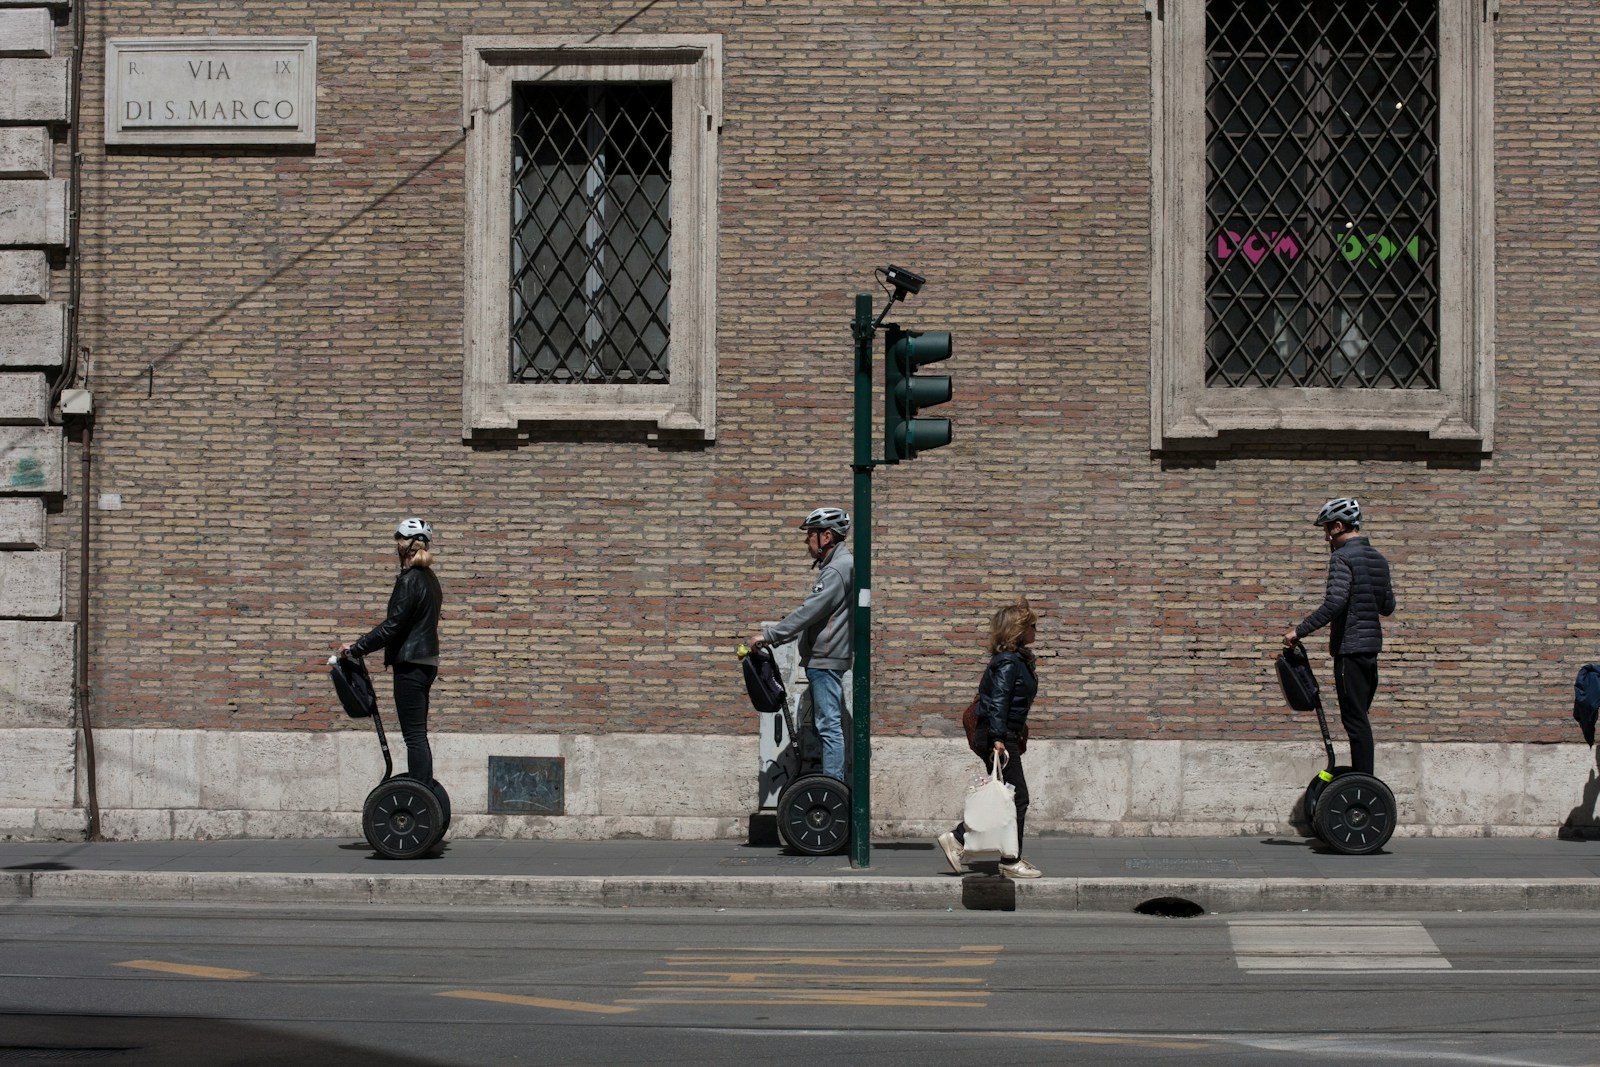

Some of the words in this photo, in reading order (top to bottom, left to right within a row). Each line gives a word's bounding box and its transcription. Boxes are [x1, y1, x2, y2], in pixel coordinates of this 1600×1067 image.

[128, 61, 145, 75] R.
[187, 60, 231, 80] VIA
[274, 60, 292, 75] IX
[125, 100, 153, 121] DI
[164, 100, 181, 121] S.
[187, 99, 295, 121] MARCO
[614, 945, 1004, 1008] TRAM
